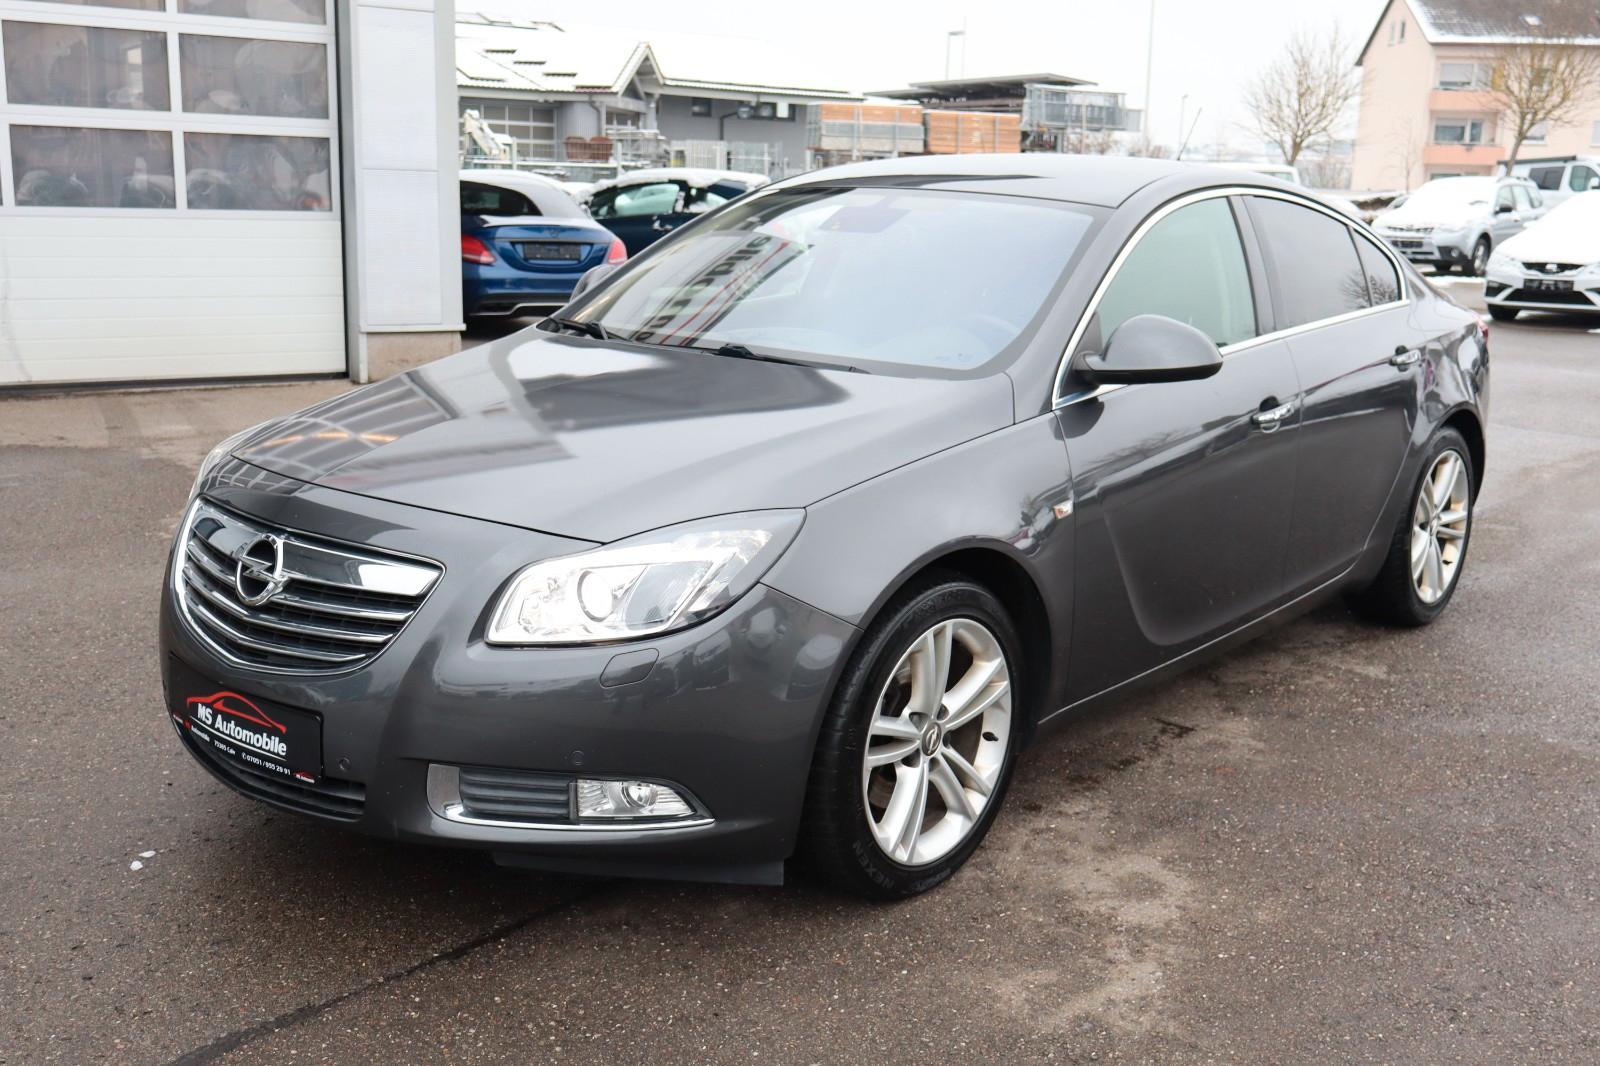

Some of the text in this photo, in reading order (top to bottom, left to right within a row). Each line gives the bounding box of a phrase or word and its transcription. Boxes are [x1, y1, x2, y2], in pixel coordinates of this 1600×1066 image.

[197, 702, 287, 756] MS Automobile
[852, 840, 895, 888] NEXEN
